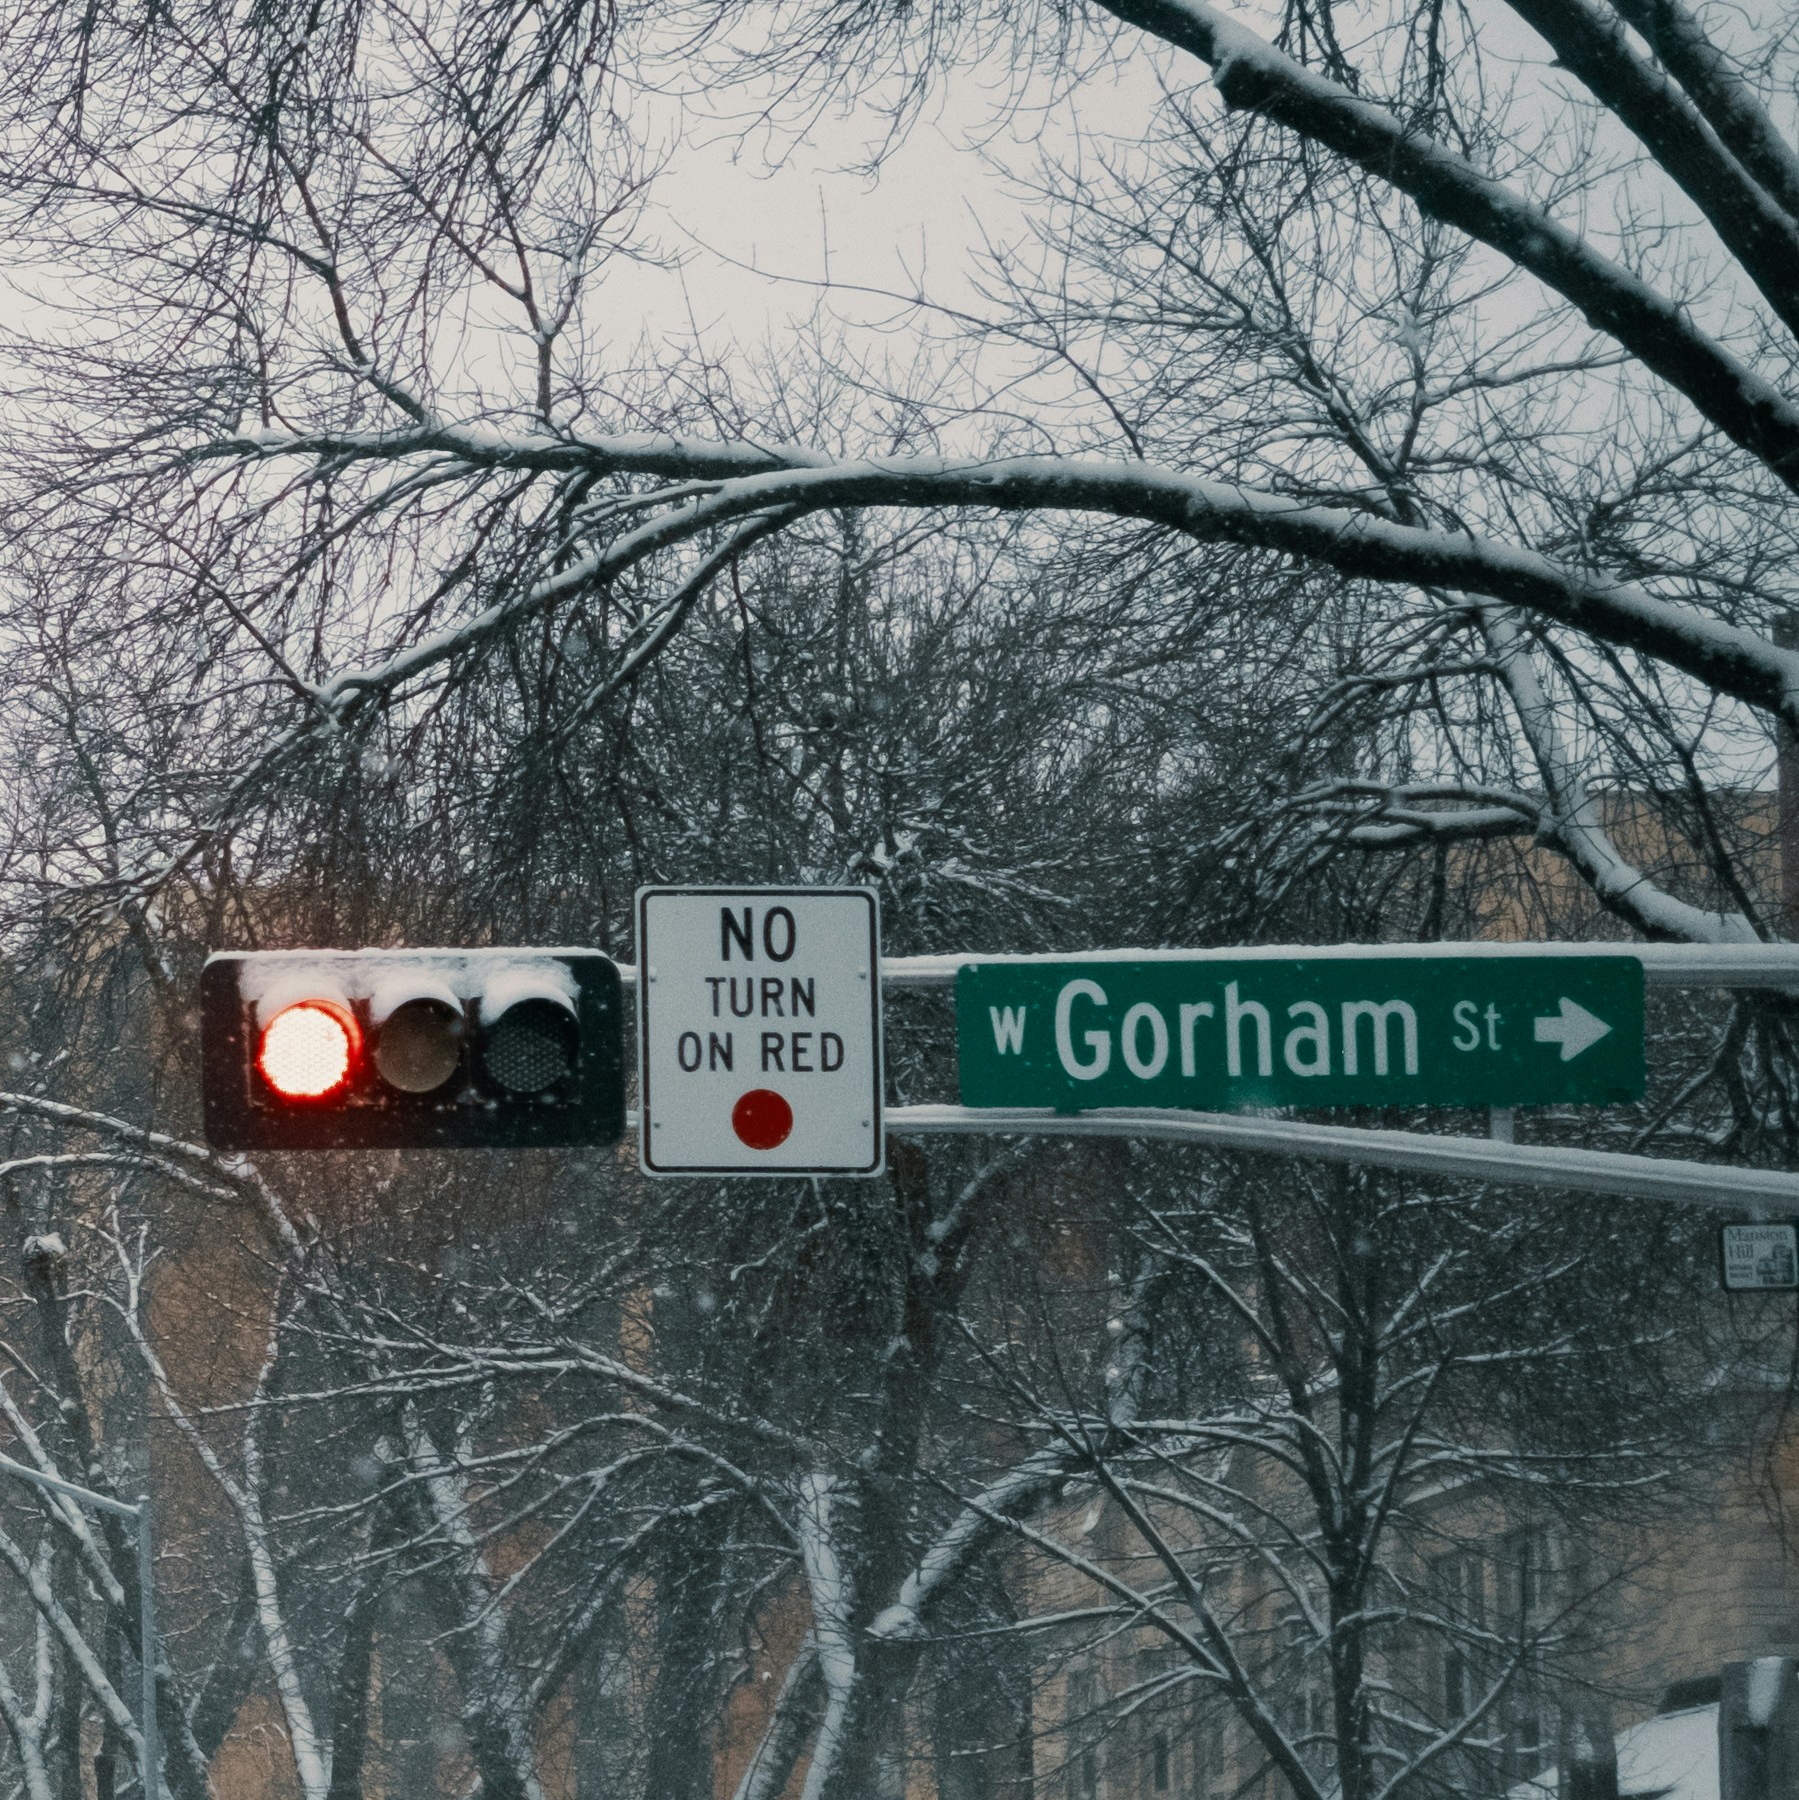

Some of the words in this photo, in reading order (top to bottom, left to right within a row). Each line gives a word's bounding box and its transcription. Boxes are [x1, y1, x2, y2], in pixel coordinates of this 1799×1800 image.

[720, 905, 797, 963] NO
[705, 976, 816, 1018] TURN
[989, 1005, 1027, 1055] W
[1054, 977, 1419, 1080] Gorham
[1452, 1000, 1502, 1051] St
[677, 1031, 733, 1073] ON
[760, 1031, 845, 1073] RED
[1728, 1228, 1788, 1242] Mansion
